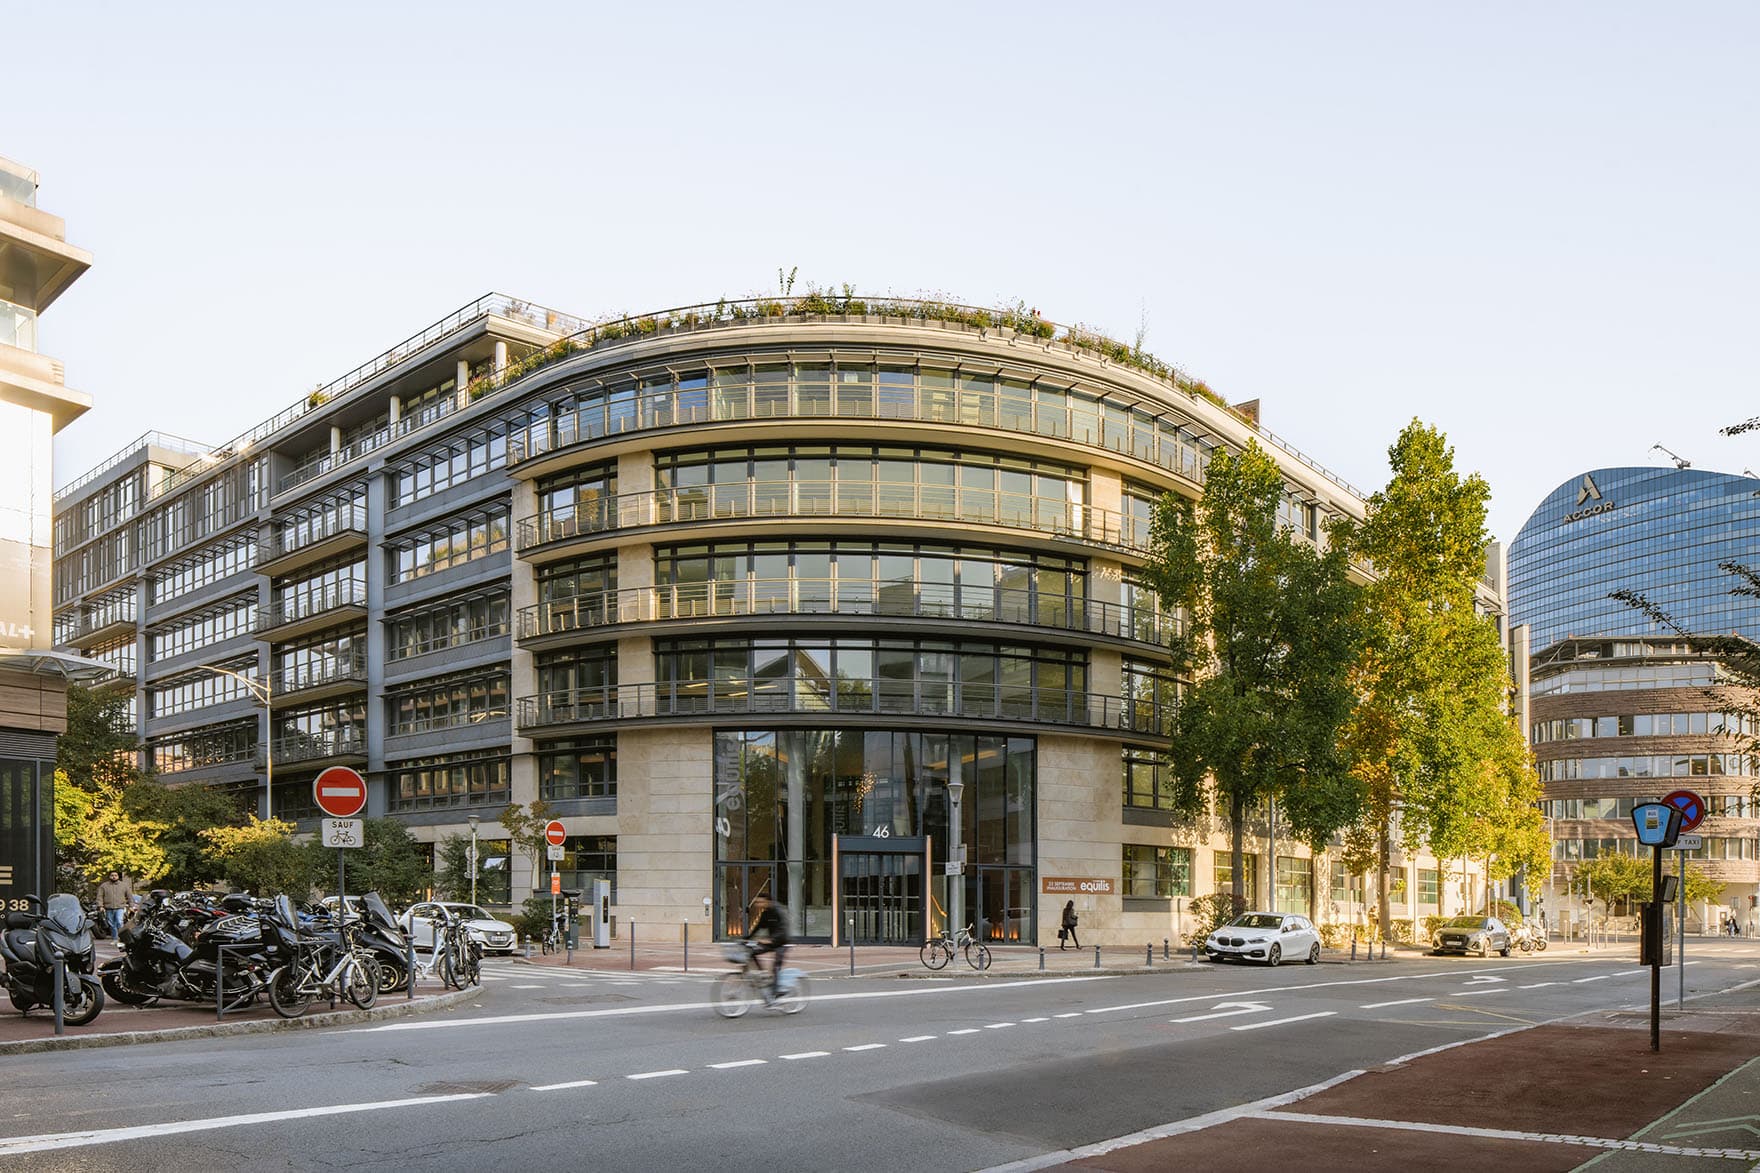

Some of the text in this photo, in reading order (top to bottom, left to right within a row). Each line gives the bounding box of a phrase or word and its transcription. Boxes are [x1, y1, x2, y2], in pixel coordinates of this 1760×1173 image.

[1563, 501, 1615, 523] ACCOR
[872, 825, 890, 839] 46
[1080, 880, 1110, 892] equilis
[9, 899, 29, 911] 38
